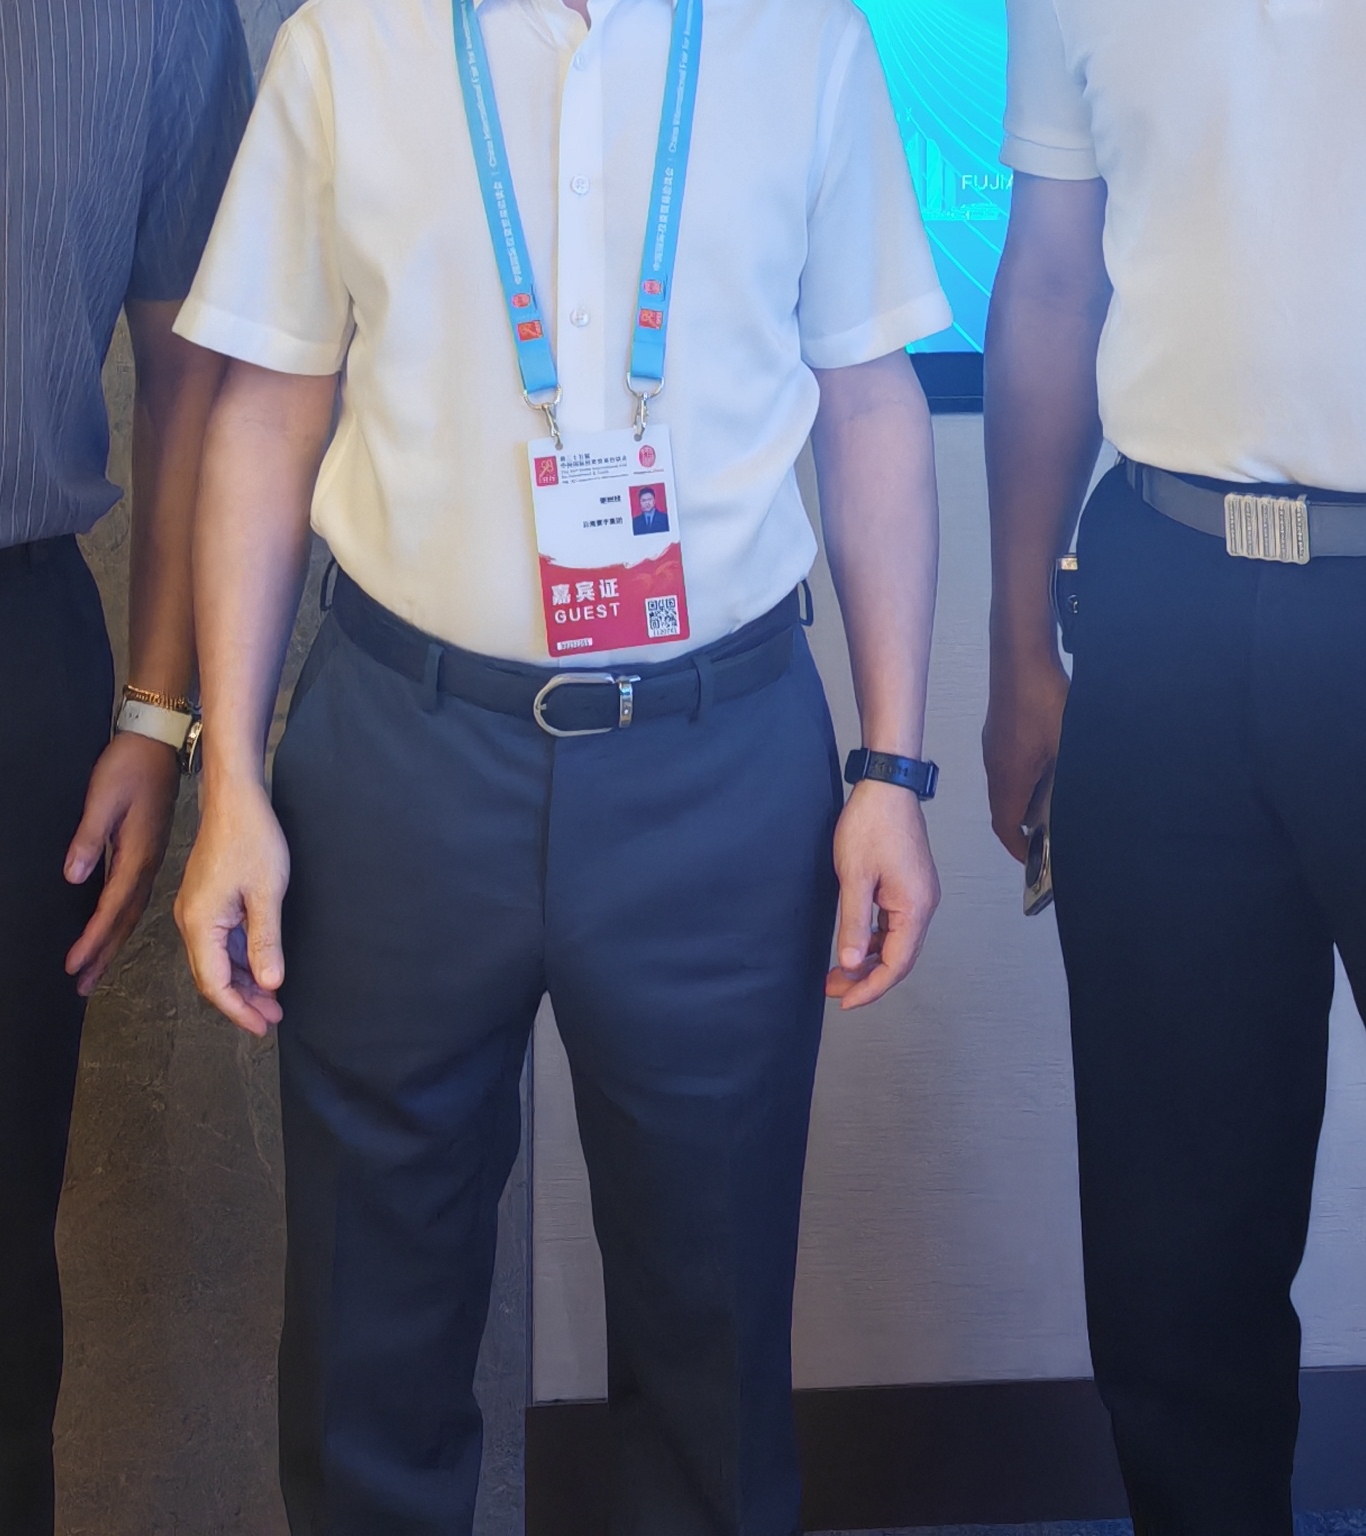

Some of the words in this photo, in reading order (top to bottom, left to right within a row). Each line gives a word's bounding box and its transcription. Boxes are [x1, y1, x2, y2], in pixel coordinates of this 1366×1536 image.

[551, 578, 619, 605] 嘉宾证
[555, 602, 620, 624] GUEST
